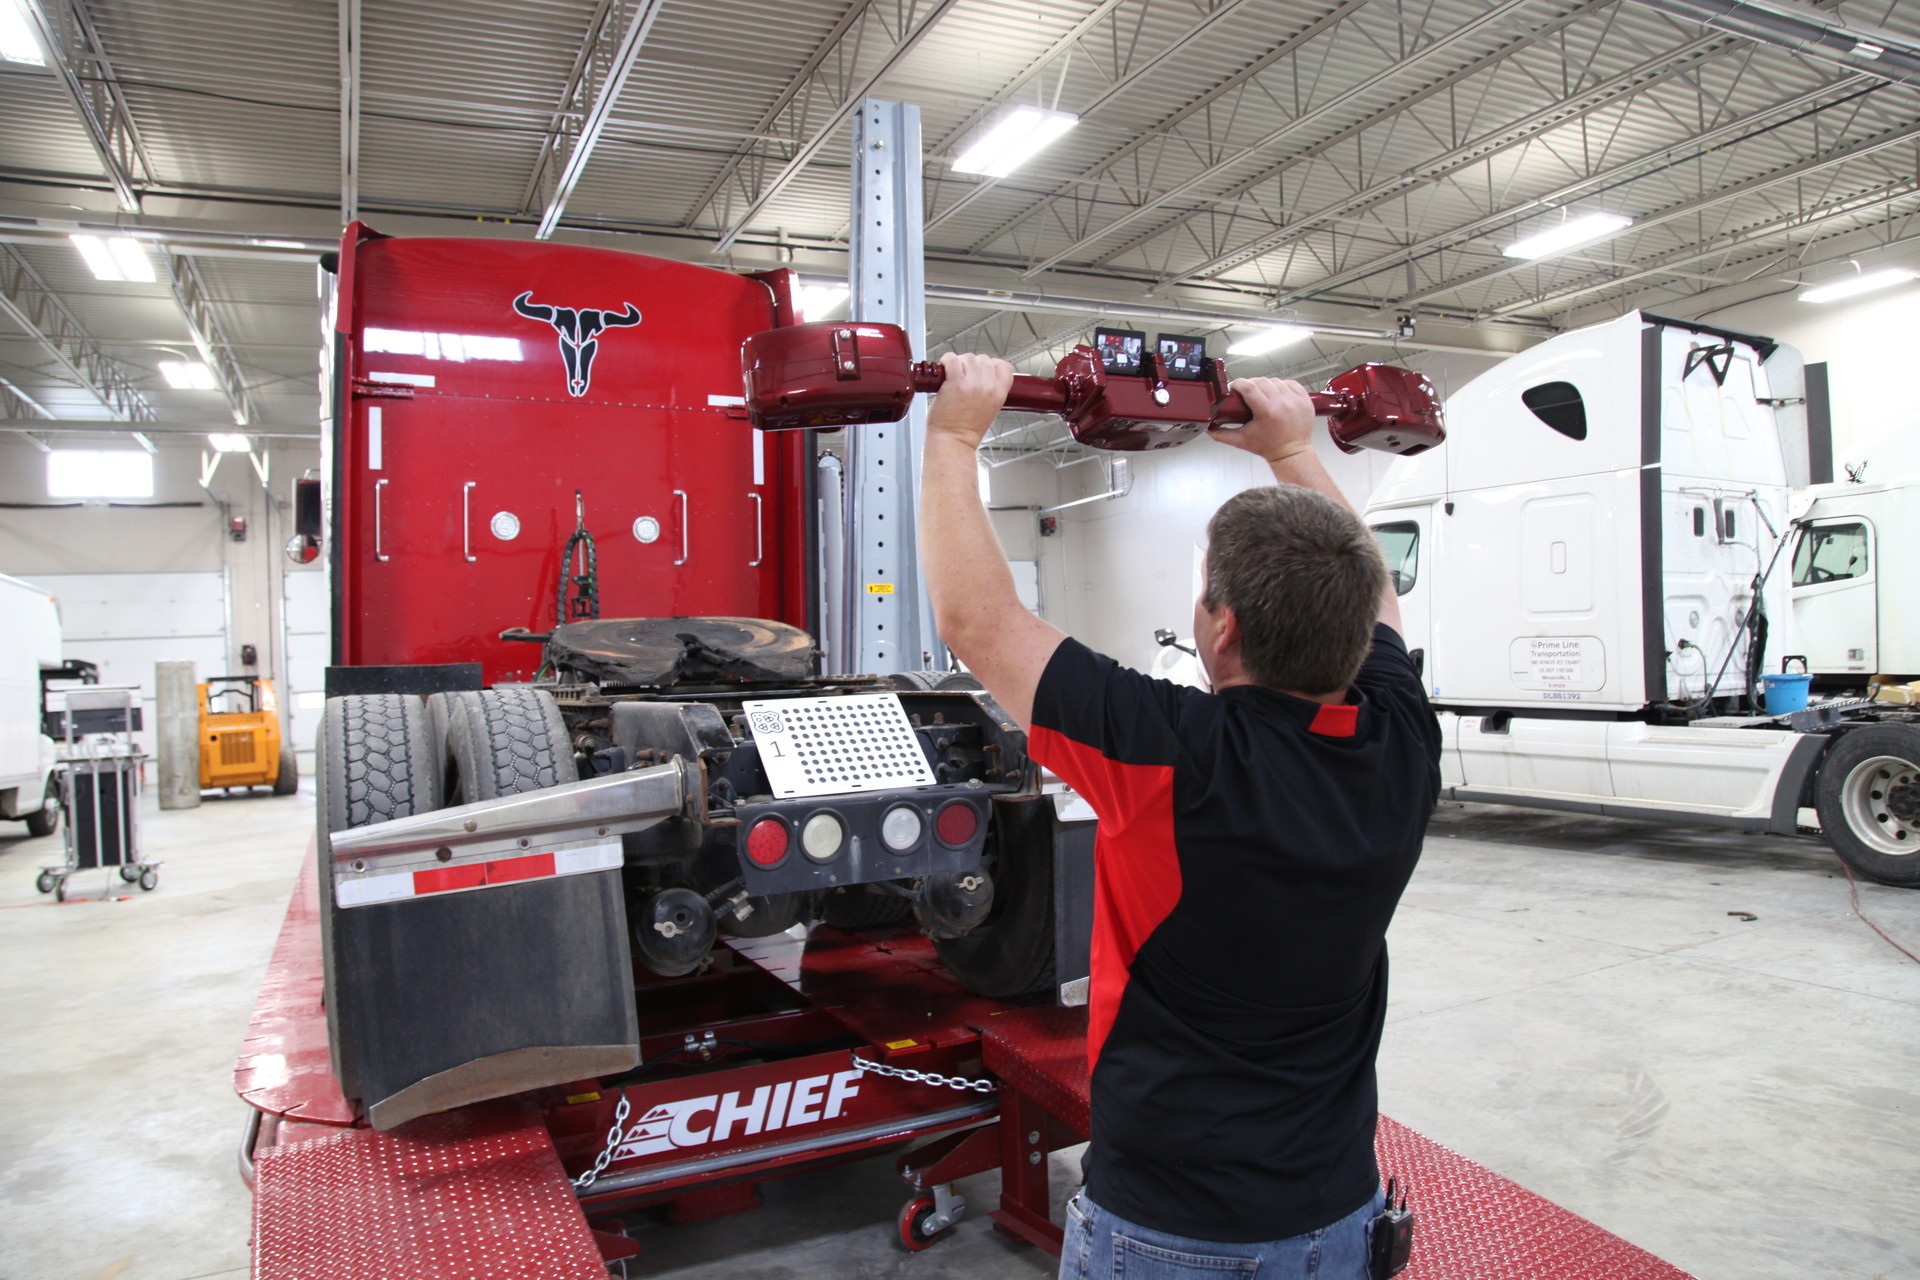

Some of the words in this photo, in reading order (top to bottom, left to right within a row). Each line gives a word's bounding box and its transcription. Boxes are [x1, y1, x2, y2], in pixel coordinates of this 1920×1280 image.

[1537, 641, 1560, 649] Prime
[1562, 641, 1579, 649] Line
[1531, 650, 1580, 658] Transportation
[770, 741, 786, 757] 1
[669, 1069, 864, 1147] CHIEF
